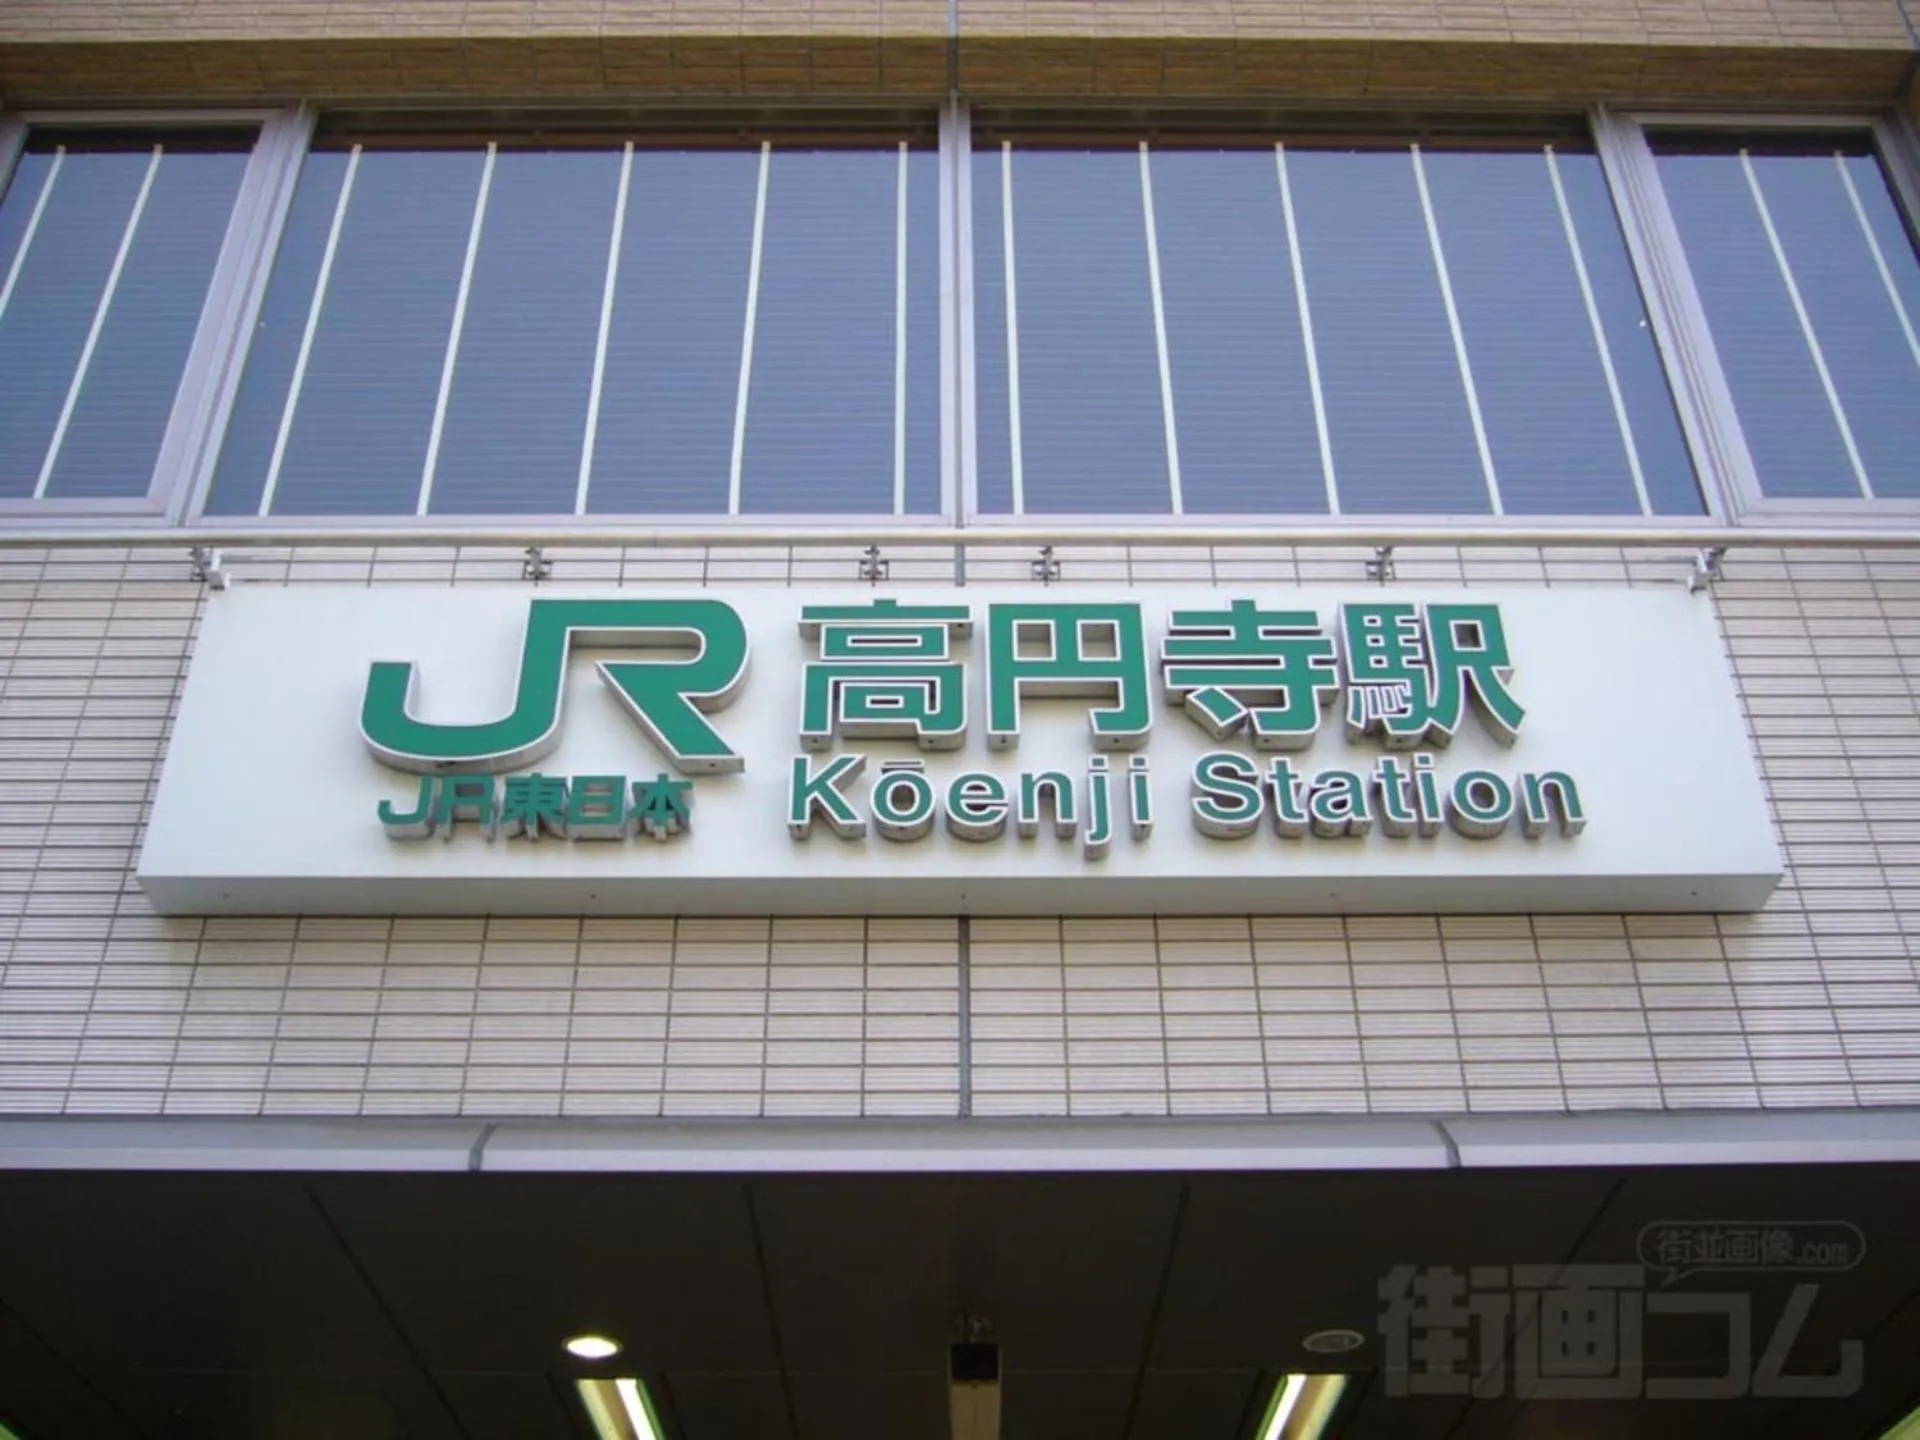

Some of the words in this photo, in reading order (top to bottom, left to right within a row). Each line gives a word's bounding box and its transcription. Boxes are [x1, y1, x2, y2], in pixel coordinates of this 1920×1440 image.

[361, 598, 747, 772] JR
[797, 598, 1528, 749] 高円寺駅
[377, 772, 694, 840] JR東日本
[787, 752, 1153, 858] Kōenji
[1190, 750, 1586, 838] Station
